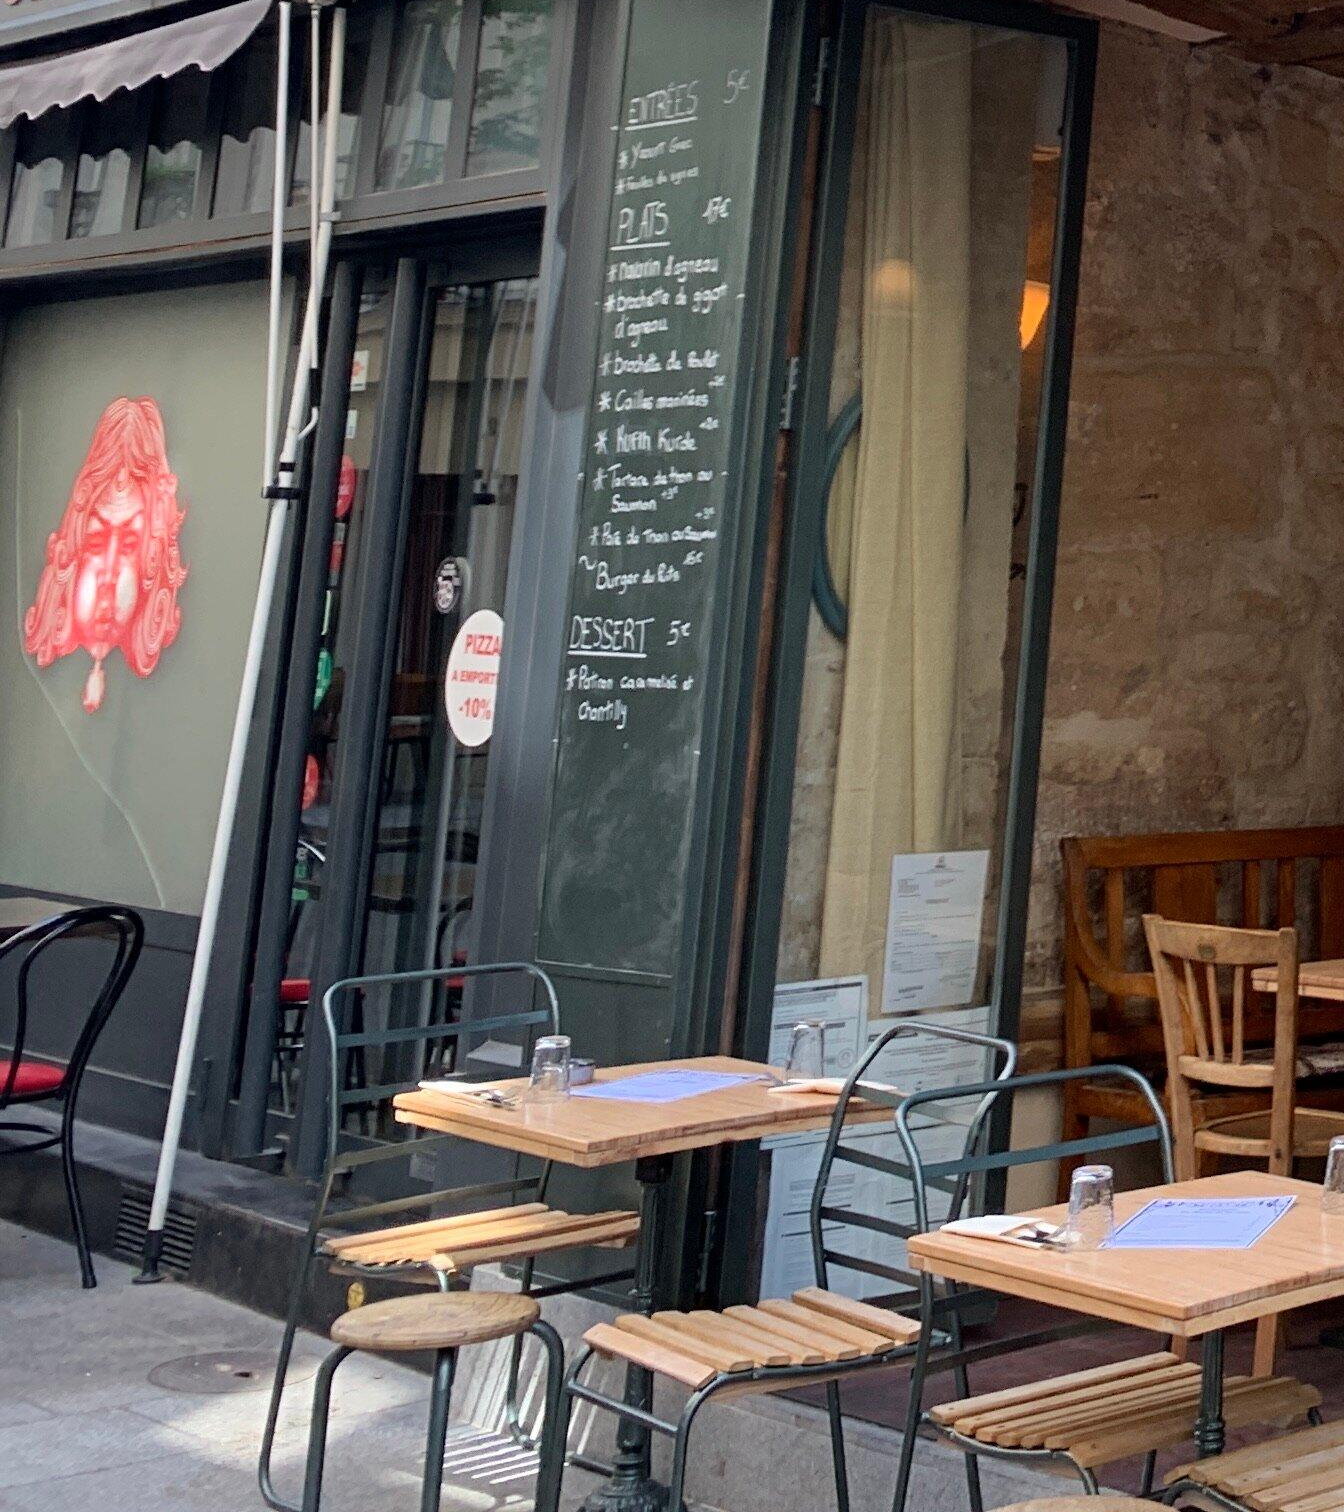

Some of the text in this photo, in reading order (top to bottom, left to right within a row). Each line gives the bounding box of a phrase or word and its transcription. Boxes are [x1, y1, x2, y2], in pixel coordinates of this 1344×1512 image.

[618, 200, 669, 244] PLATS
[595, 561, 640, 595] Burger
[569, 614, 656, 654] DESSERT
[458, 697, 492, 721] -10%
